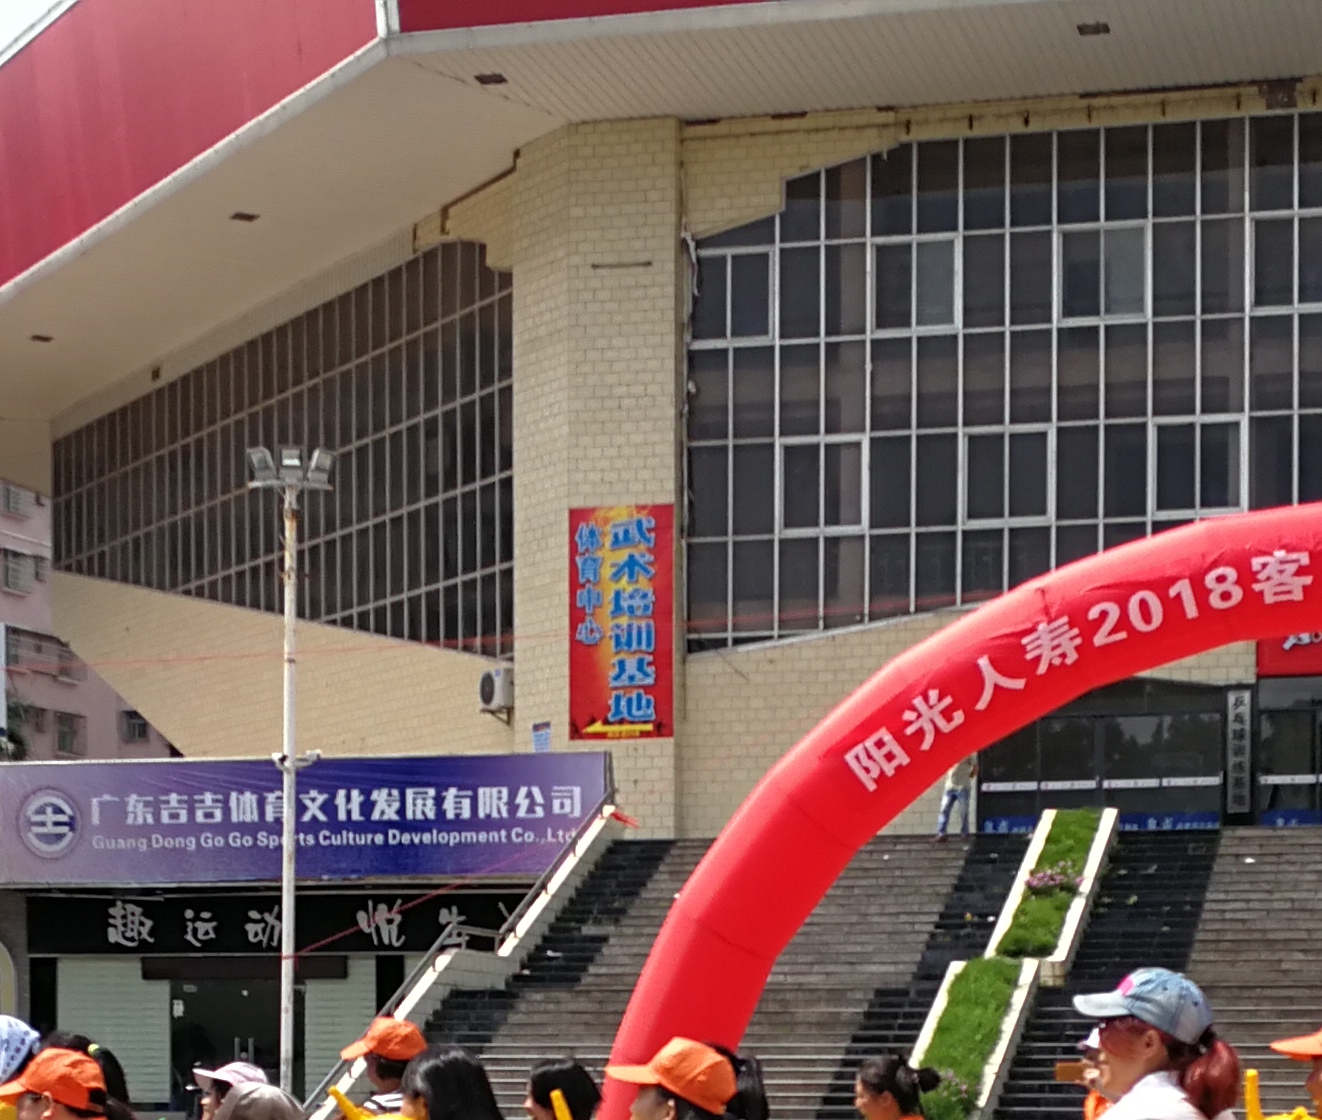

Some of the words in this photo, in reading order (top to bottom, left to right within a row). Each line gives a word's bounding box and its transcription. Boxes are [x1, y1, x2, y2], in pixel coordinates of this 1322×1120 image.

[575, 521, 603, 645] 体育中心
[608, 516, 656, 722] 武术培训基地
[90, 784, 582, 826] 广东吉吉体育文化发展有限公司
[92, 834, 151, 851] Guang
[151, 833, 196, 850] Dong
[200, 832, 224, 848] Go
[228, 831, 253, 847] Go
[257, 829, 315, 849] Spts
[318, 830, 385, 847] Culture
[387, 827, 507, 846] Development
